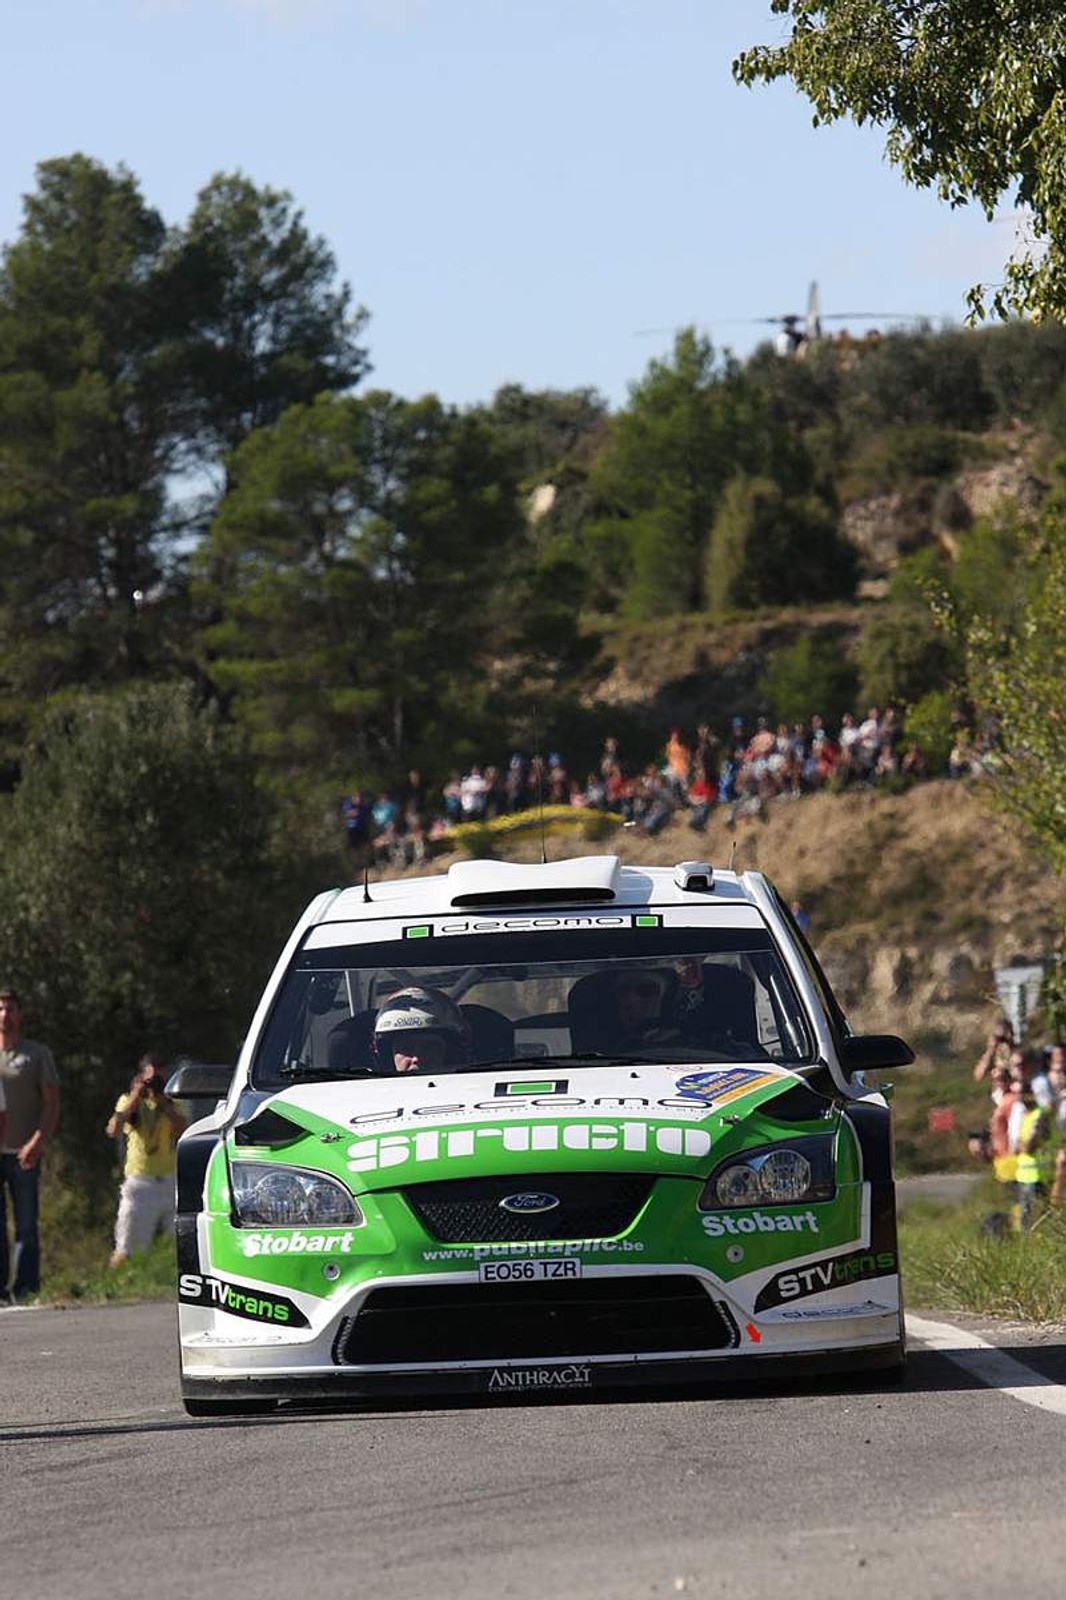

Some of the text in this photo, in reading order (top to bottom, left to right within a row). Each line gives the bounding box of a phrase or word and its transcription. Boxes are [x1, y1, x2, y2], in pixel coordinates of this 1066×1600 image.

[441, 916, 624, 933] decomo
[350, 1097, 713, 1124] decomo
[346, 1122, 712, 1173] structo
[513, 1194, 547, 1207] Ford
[702, 1211, 819, 1237] Stobart
[242, 1232, 355, 1258] Stobart
[484, 1260, 577, 1281] EO56 TZR
